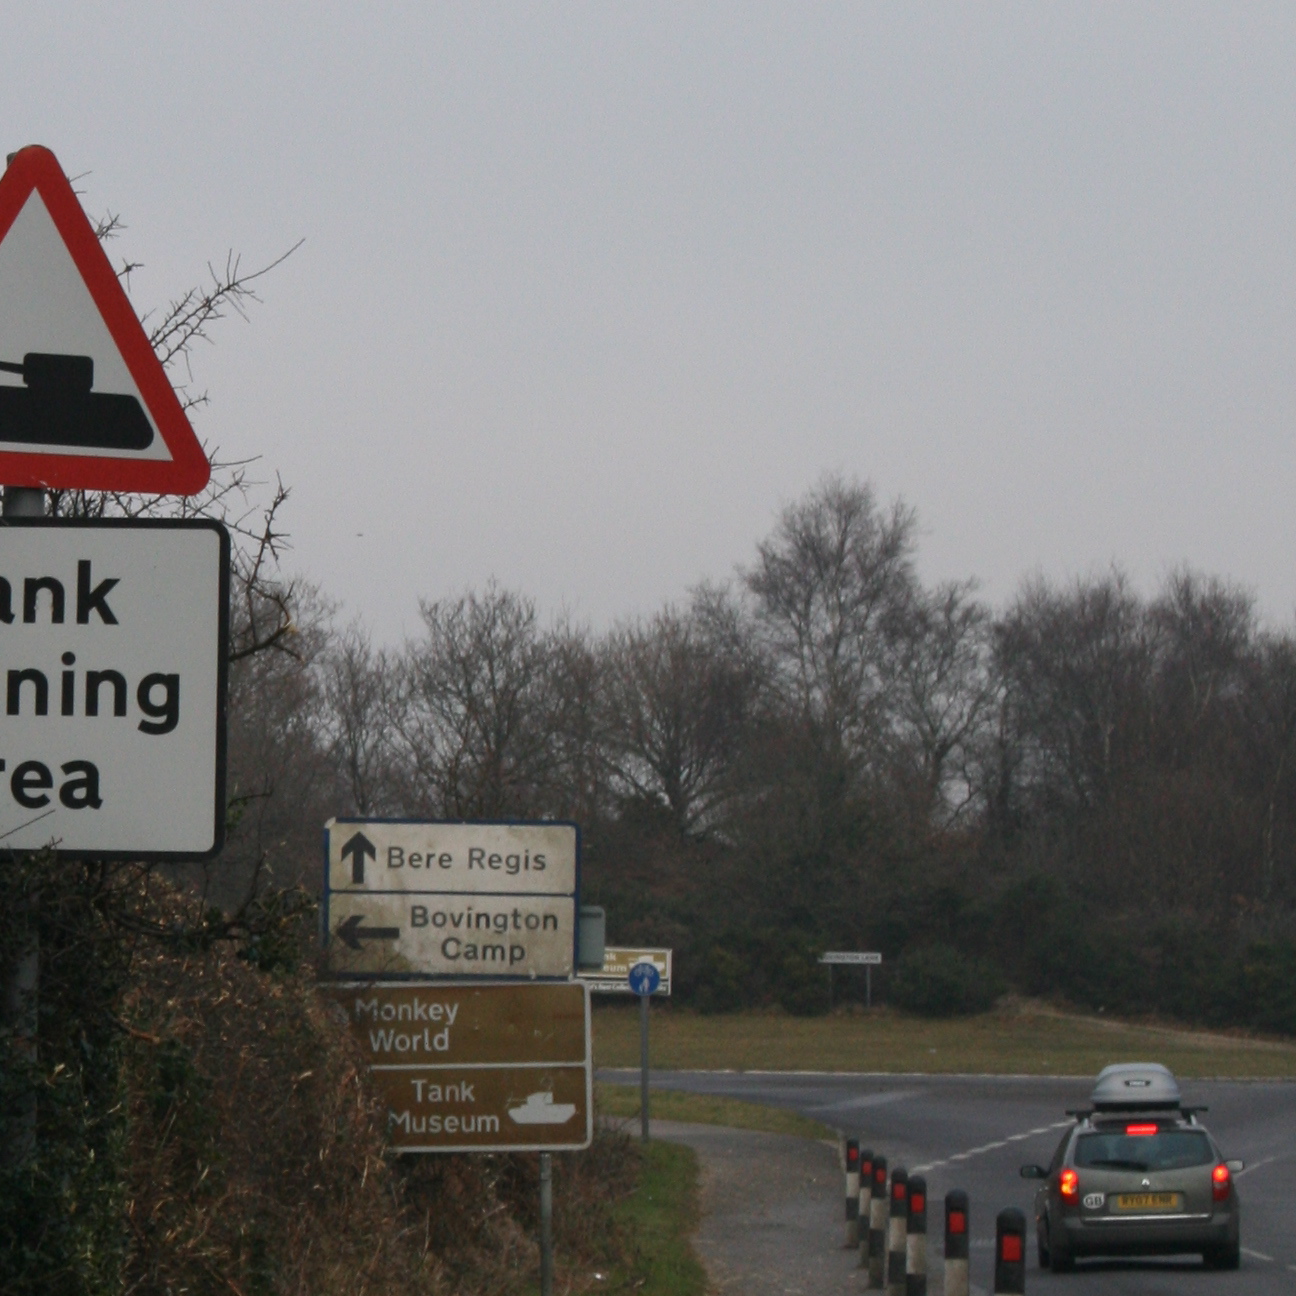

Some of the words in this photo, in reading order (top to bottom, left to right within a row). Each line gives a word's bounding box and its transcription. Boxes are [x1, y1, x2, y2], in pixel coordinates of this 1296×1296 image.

[387, 846, 453, 870] Bere
[468, 847, 547, 875] Regis
[410, 905, 559, 933] Bovington
[441, 937, 526, 966] Camp
[355, 998, 459, 1025] Monkey
[369, 1027, 450, 1052] World
[411, 1079, 475, 1103] Tank
[388, 1111, 500, 1134] Museum
[1085, 1196, 1103, 1207] GB
